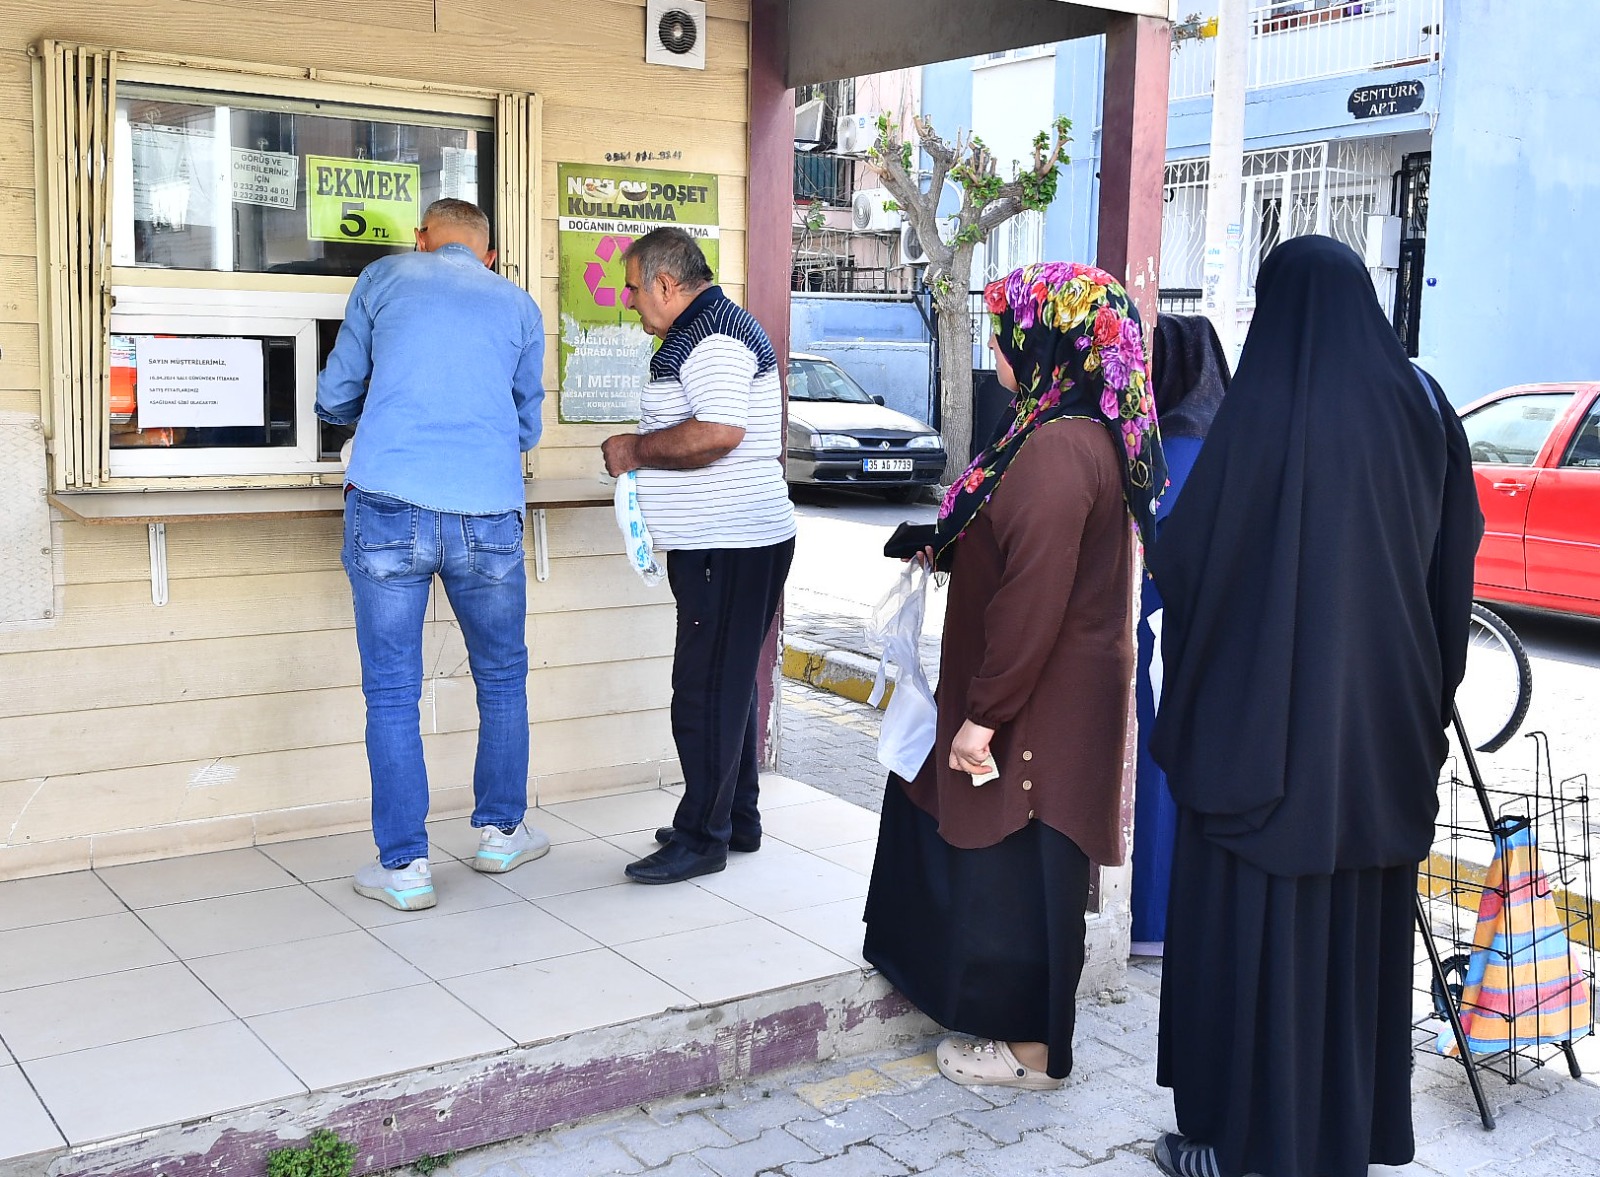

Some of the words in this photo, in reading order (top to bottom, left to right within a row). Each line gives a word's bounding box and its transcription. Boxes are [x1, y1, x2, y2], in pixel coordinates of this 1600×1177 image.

[1369, 101, 1398, 116] APT.
[241, 154, 270, 166] GÖRÜŞ
[271, 158, 283, 167] VE
[233, 162, 289, 177] ÖNERİLERİNİZ
[254, 174, 270, 183] İÇİN
[316, 165, 413, 203] EKMEK
[240, 183, 254, 191] 232
[254, 185, 268, 193] 293
[280, 188, 289, 196] 01
[650, 183, 708, 206] POŞET
[240, 192, 254, 200] 232
[254, 193, 268, 202] 293
[280, 197, 289, 205] 02
[568, 197, 676, 221] KULLANMA
[339, 202, 367, 237] 5
[372, 227, 390, 239] TL
[568, 218, 615, 232] DOĞANIN
[574, 347, 614, 357] BURADA
[170, 358, 227, 367] MÜŞTERİLERİMİZ,
[576, 375, 582, 388] 1
[587, 374, 641, 388] METRE
[869, 460, 877, 469] 35
[882, 460, 891, 469] AG
[893, 460, 911, 469] 7739
